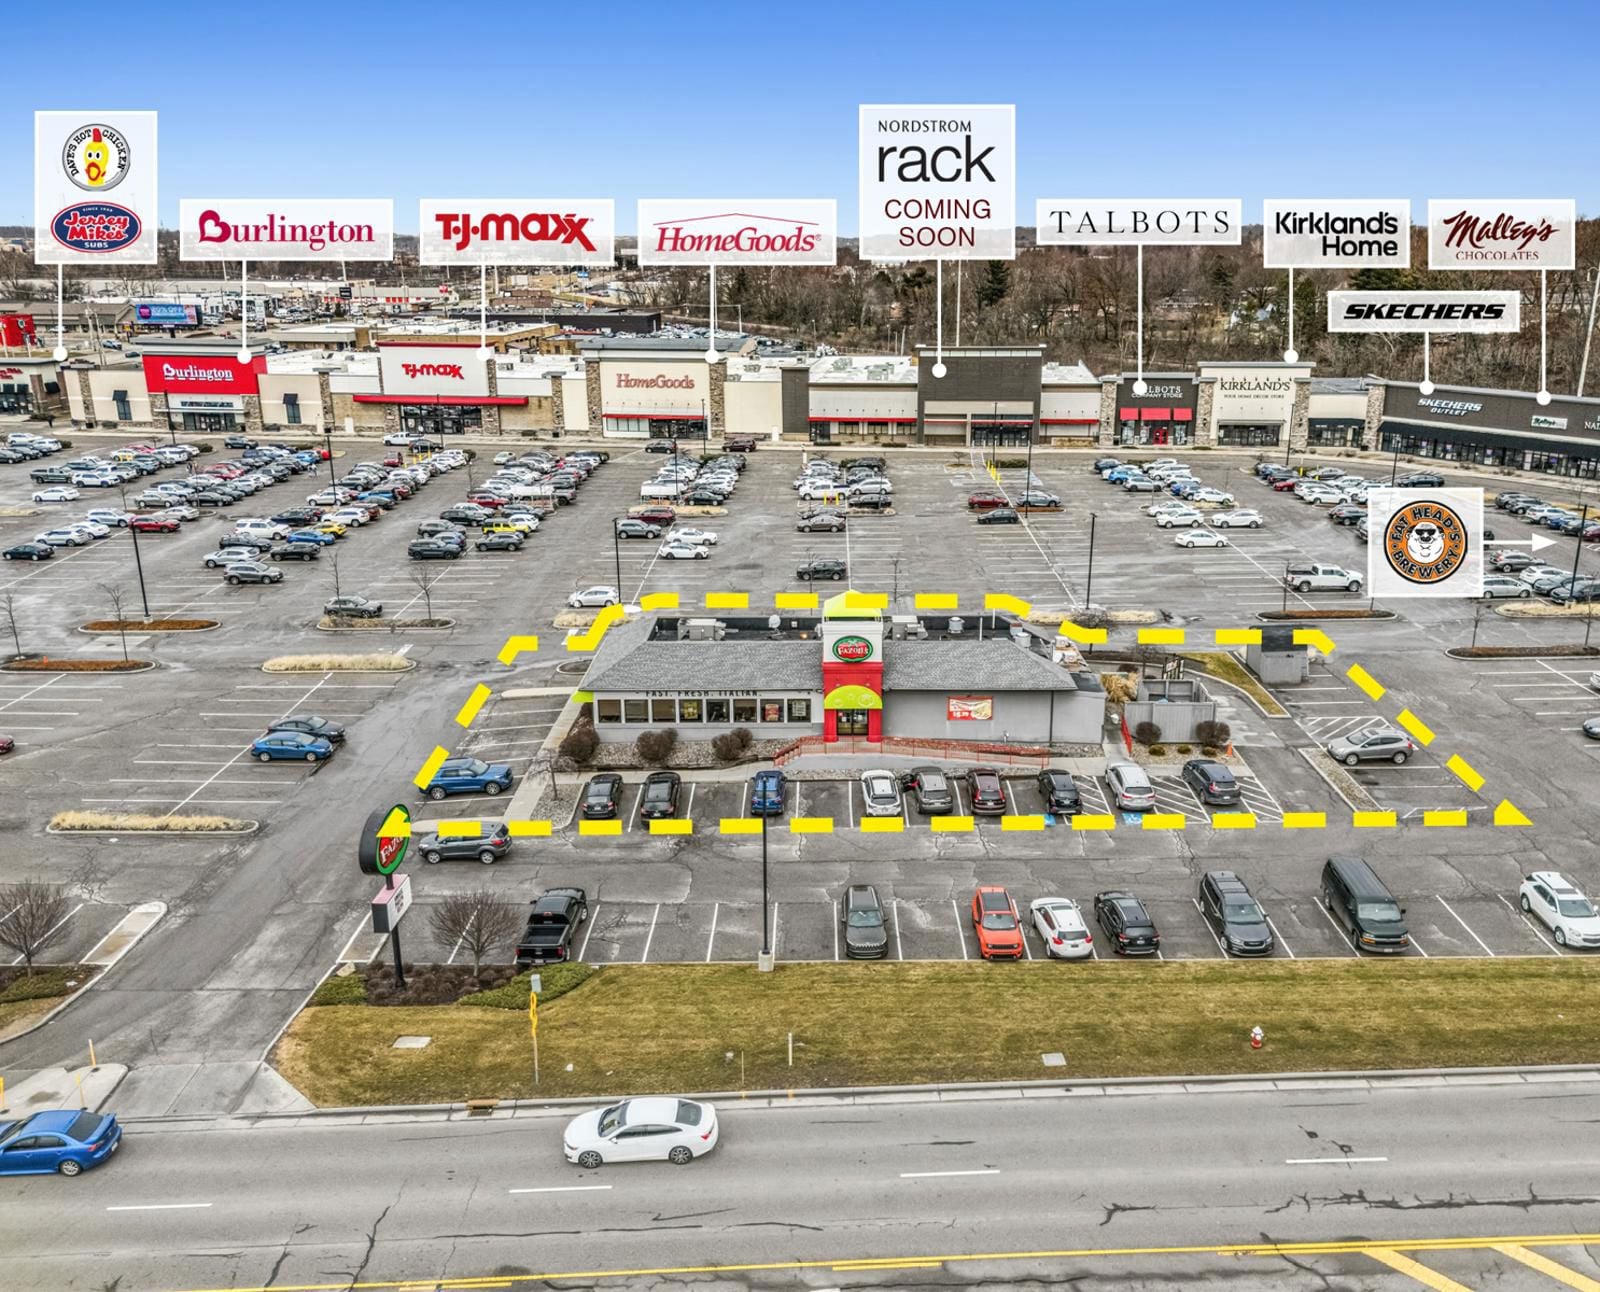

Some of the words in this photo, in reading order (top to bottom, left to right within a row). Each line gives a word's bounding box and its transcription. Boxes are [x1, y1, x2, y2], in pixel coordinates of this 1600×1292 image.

[162, 363, 233, 381] Burlington
[616, 373, 695, 389] HomeGoods
[1220, 382, 1290, 391] KIRKLAND'S
[1417, 398, 1484, 412] SKECHERS
[1430, 407, 1468, 417] OUTLET
